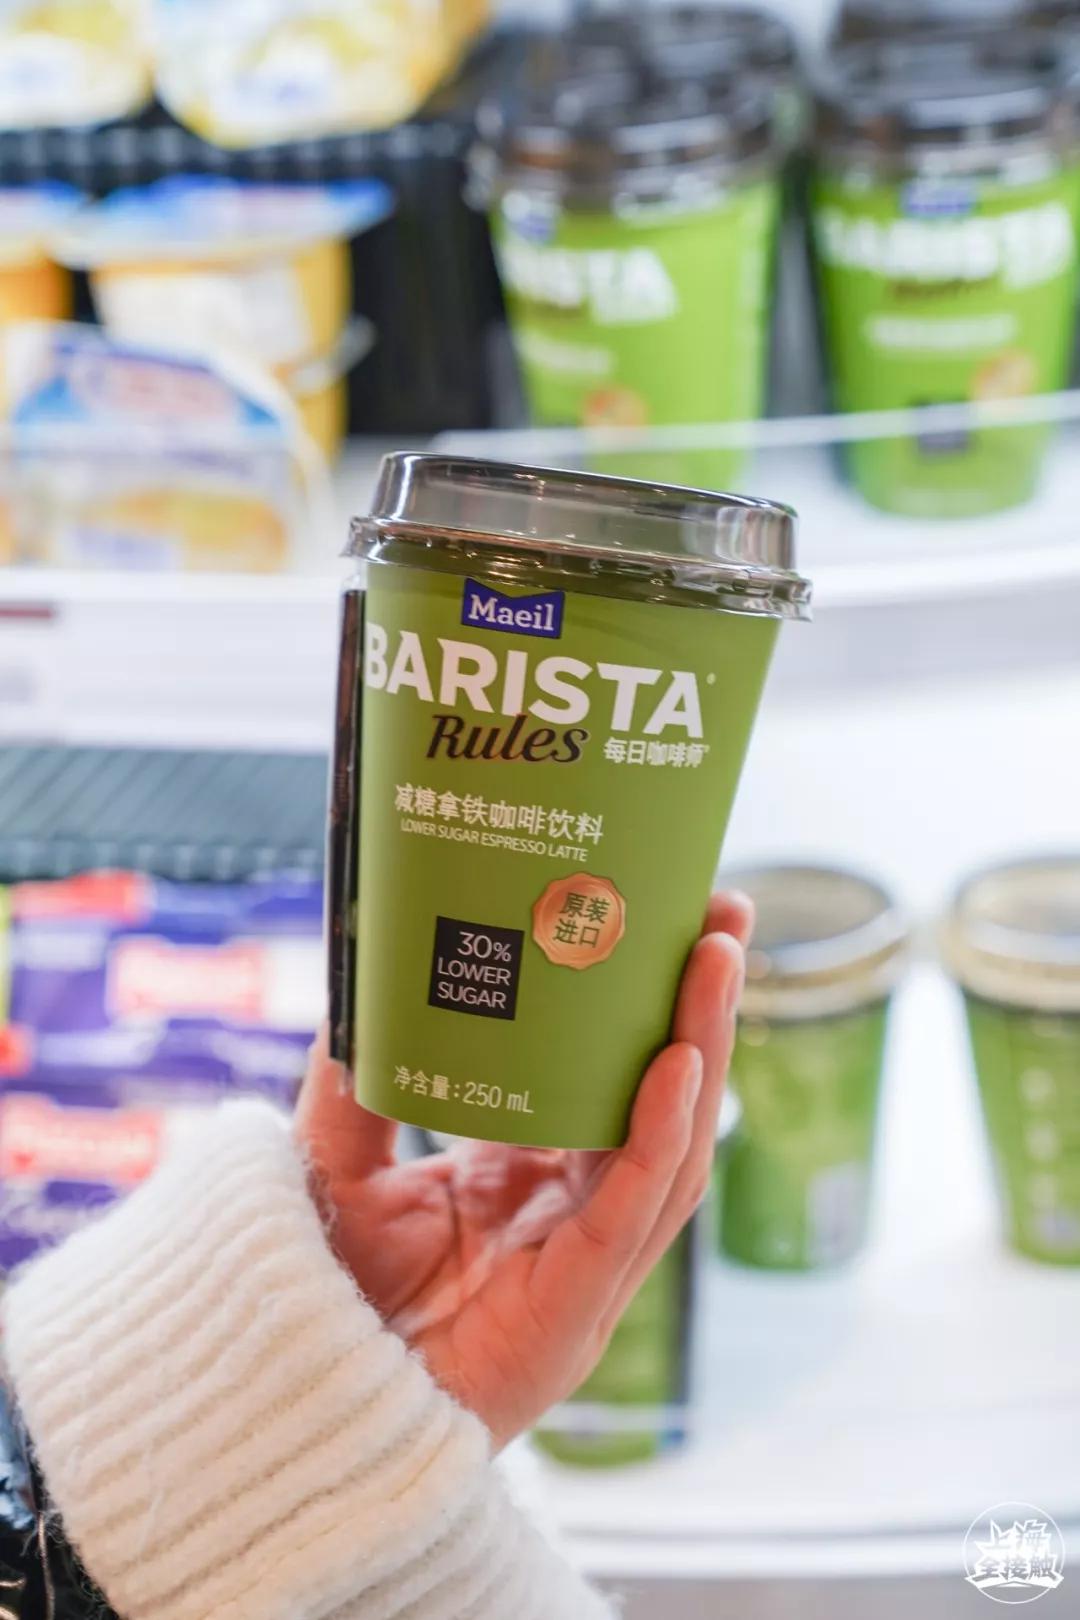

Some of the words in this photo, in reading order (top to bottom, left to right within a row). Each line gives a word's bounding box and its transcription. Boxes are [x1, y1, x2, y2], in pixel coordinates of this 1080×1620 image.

[468, 594, 555, 631] Maeil
[364, 621, 704, 739] BARISTA
[426, 713, 590, 764] Rules
[394, 783, 604, 845] 减糖拿铁咖啡饮料
[400, 818, 437, 836] LOWER
[438, 824, 480, 845] SUGAR
[481, 832, 546, 855] ESPRESSO
[548, 844, 588, 862] LATTE
[560, 892, 611, 924] 原装
[456, 931, 512, 962] 30%
[553, 918, 600, 948] 进口
[437, 957, 512, 986] LOWER
[437, 982, 507, 1009] SUGAR
[506, 1091, 535, 1114] mL
